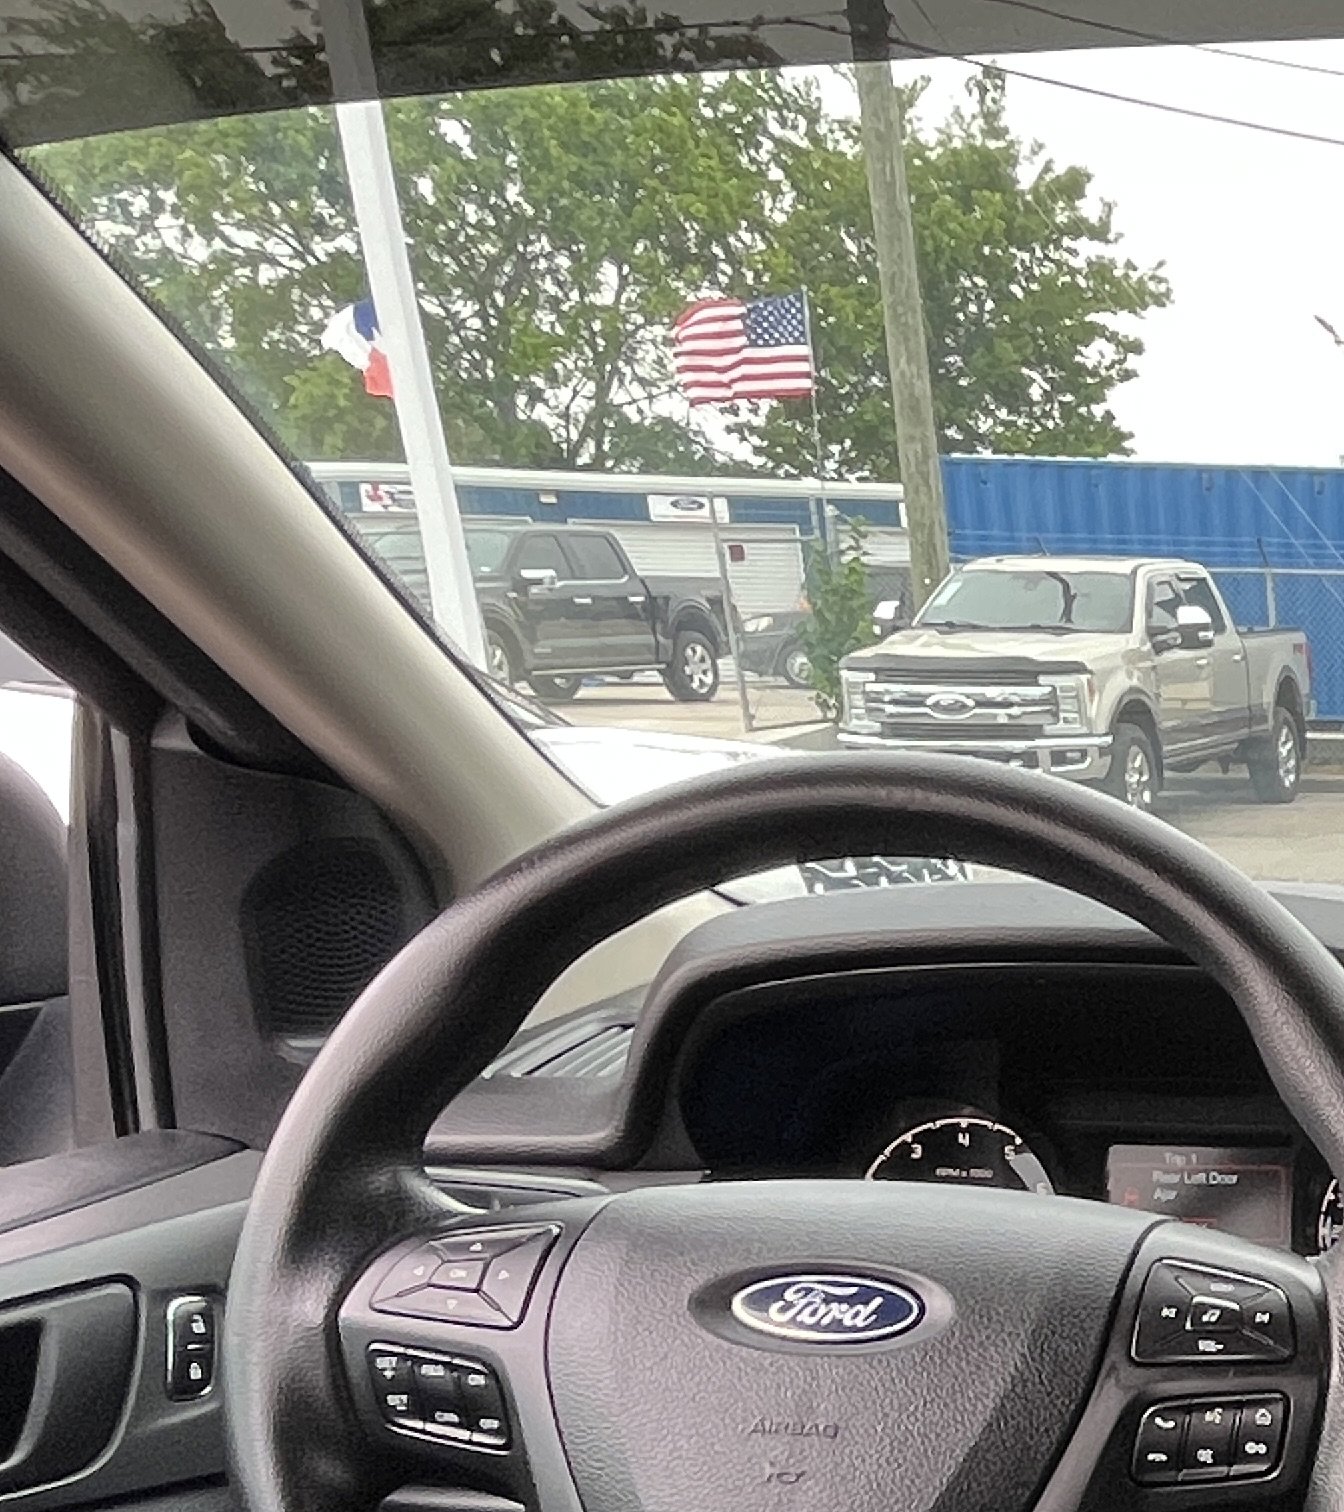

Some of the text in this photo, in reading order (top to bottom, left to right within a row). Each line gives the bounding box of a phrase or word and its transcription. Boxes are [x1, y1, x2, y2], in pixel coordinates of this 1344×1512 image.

[957, 1132, 971, 1148] 4
[910, 1142, 923, 1160] 3
[1004, 1143, 1017, 1160] 5
[1163, 1151, 1187, 1168] Trip
[1183, 1170, 1207, 1185] Left
[1207, 1170, 1239, 1185] Door
[767, 1281, 884, 1328] Ford
